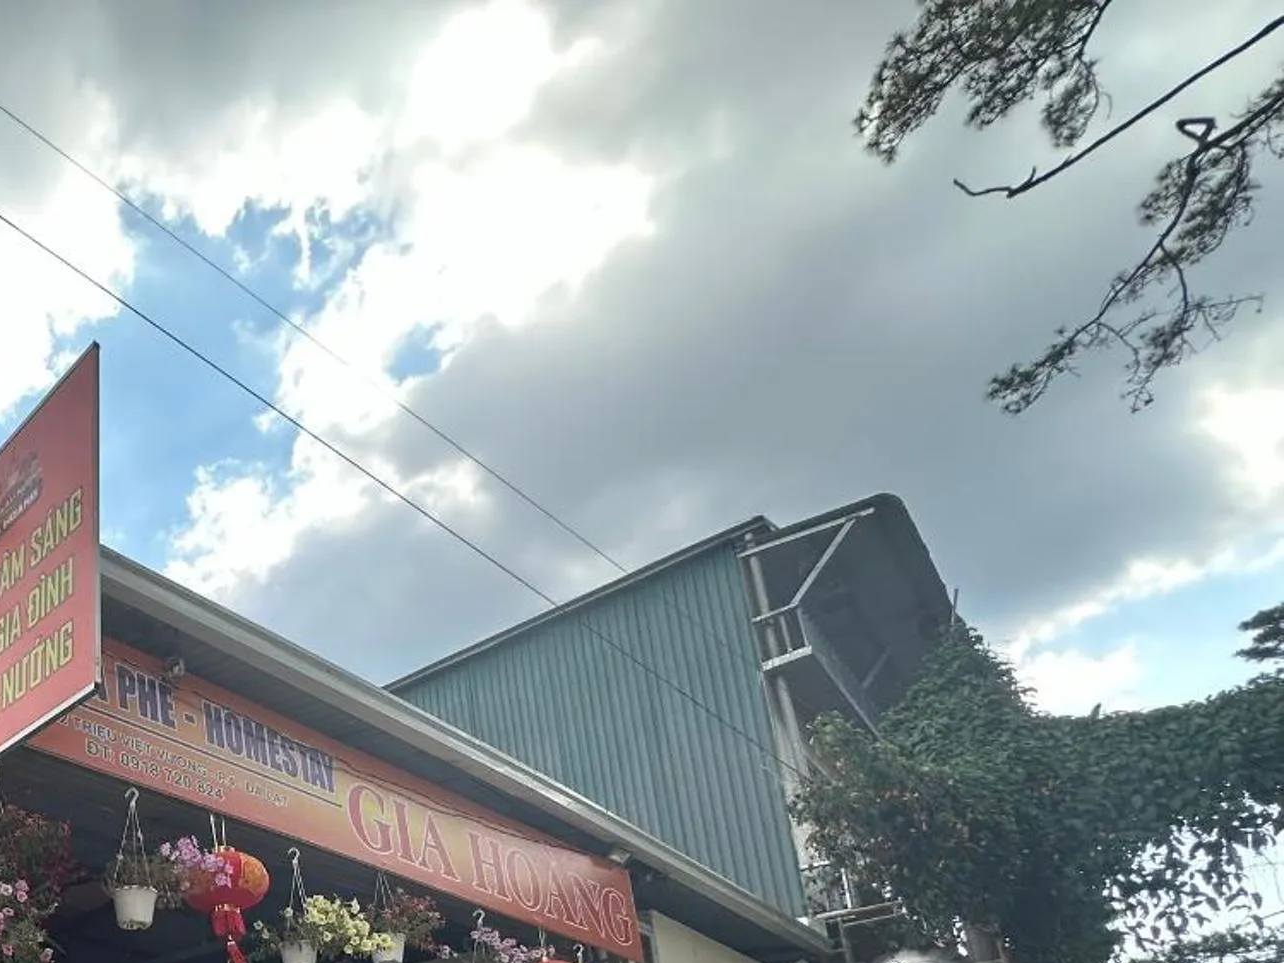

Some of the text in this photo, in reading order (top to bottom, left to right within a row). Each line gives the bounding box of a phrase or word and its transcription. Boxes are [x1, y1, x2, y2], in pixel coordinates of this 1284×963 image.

[30, 486, 83, 568] SÁNG
[27, 556, 74, 630] ĐÌNH
[119, 750, 159, 778] 0918
[162, 766, 192, 789] 720
[196, 779, 226, 801] 824
[201, 699, 336, 794] HOMESTAY
[347, 782, 462, 883] GIA
